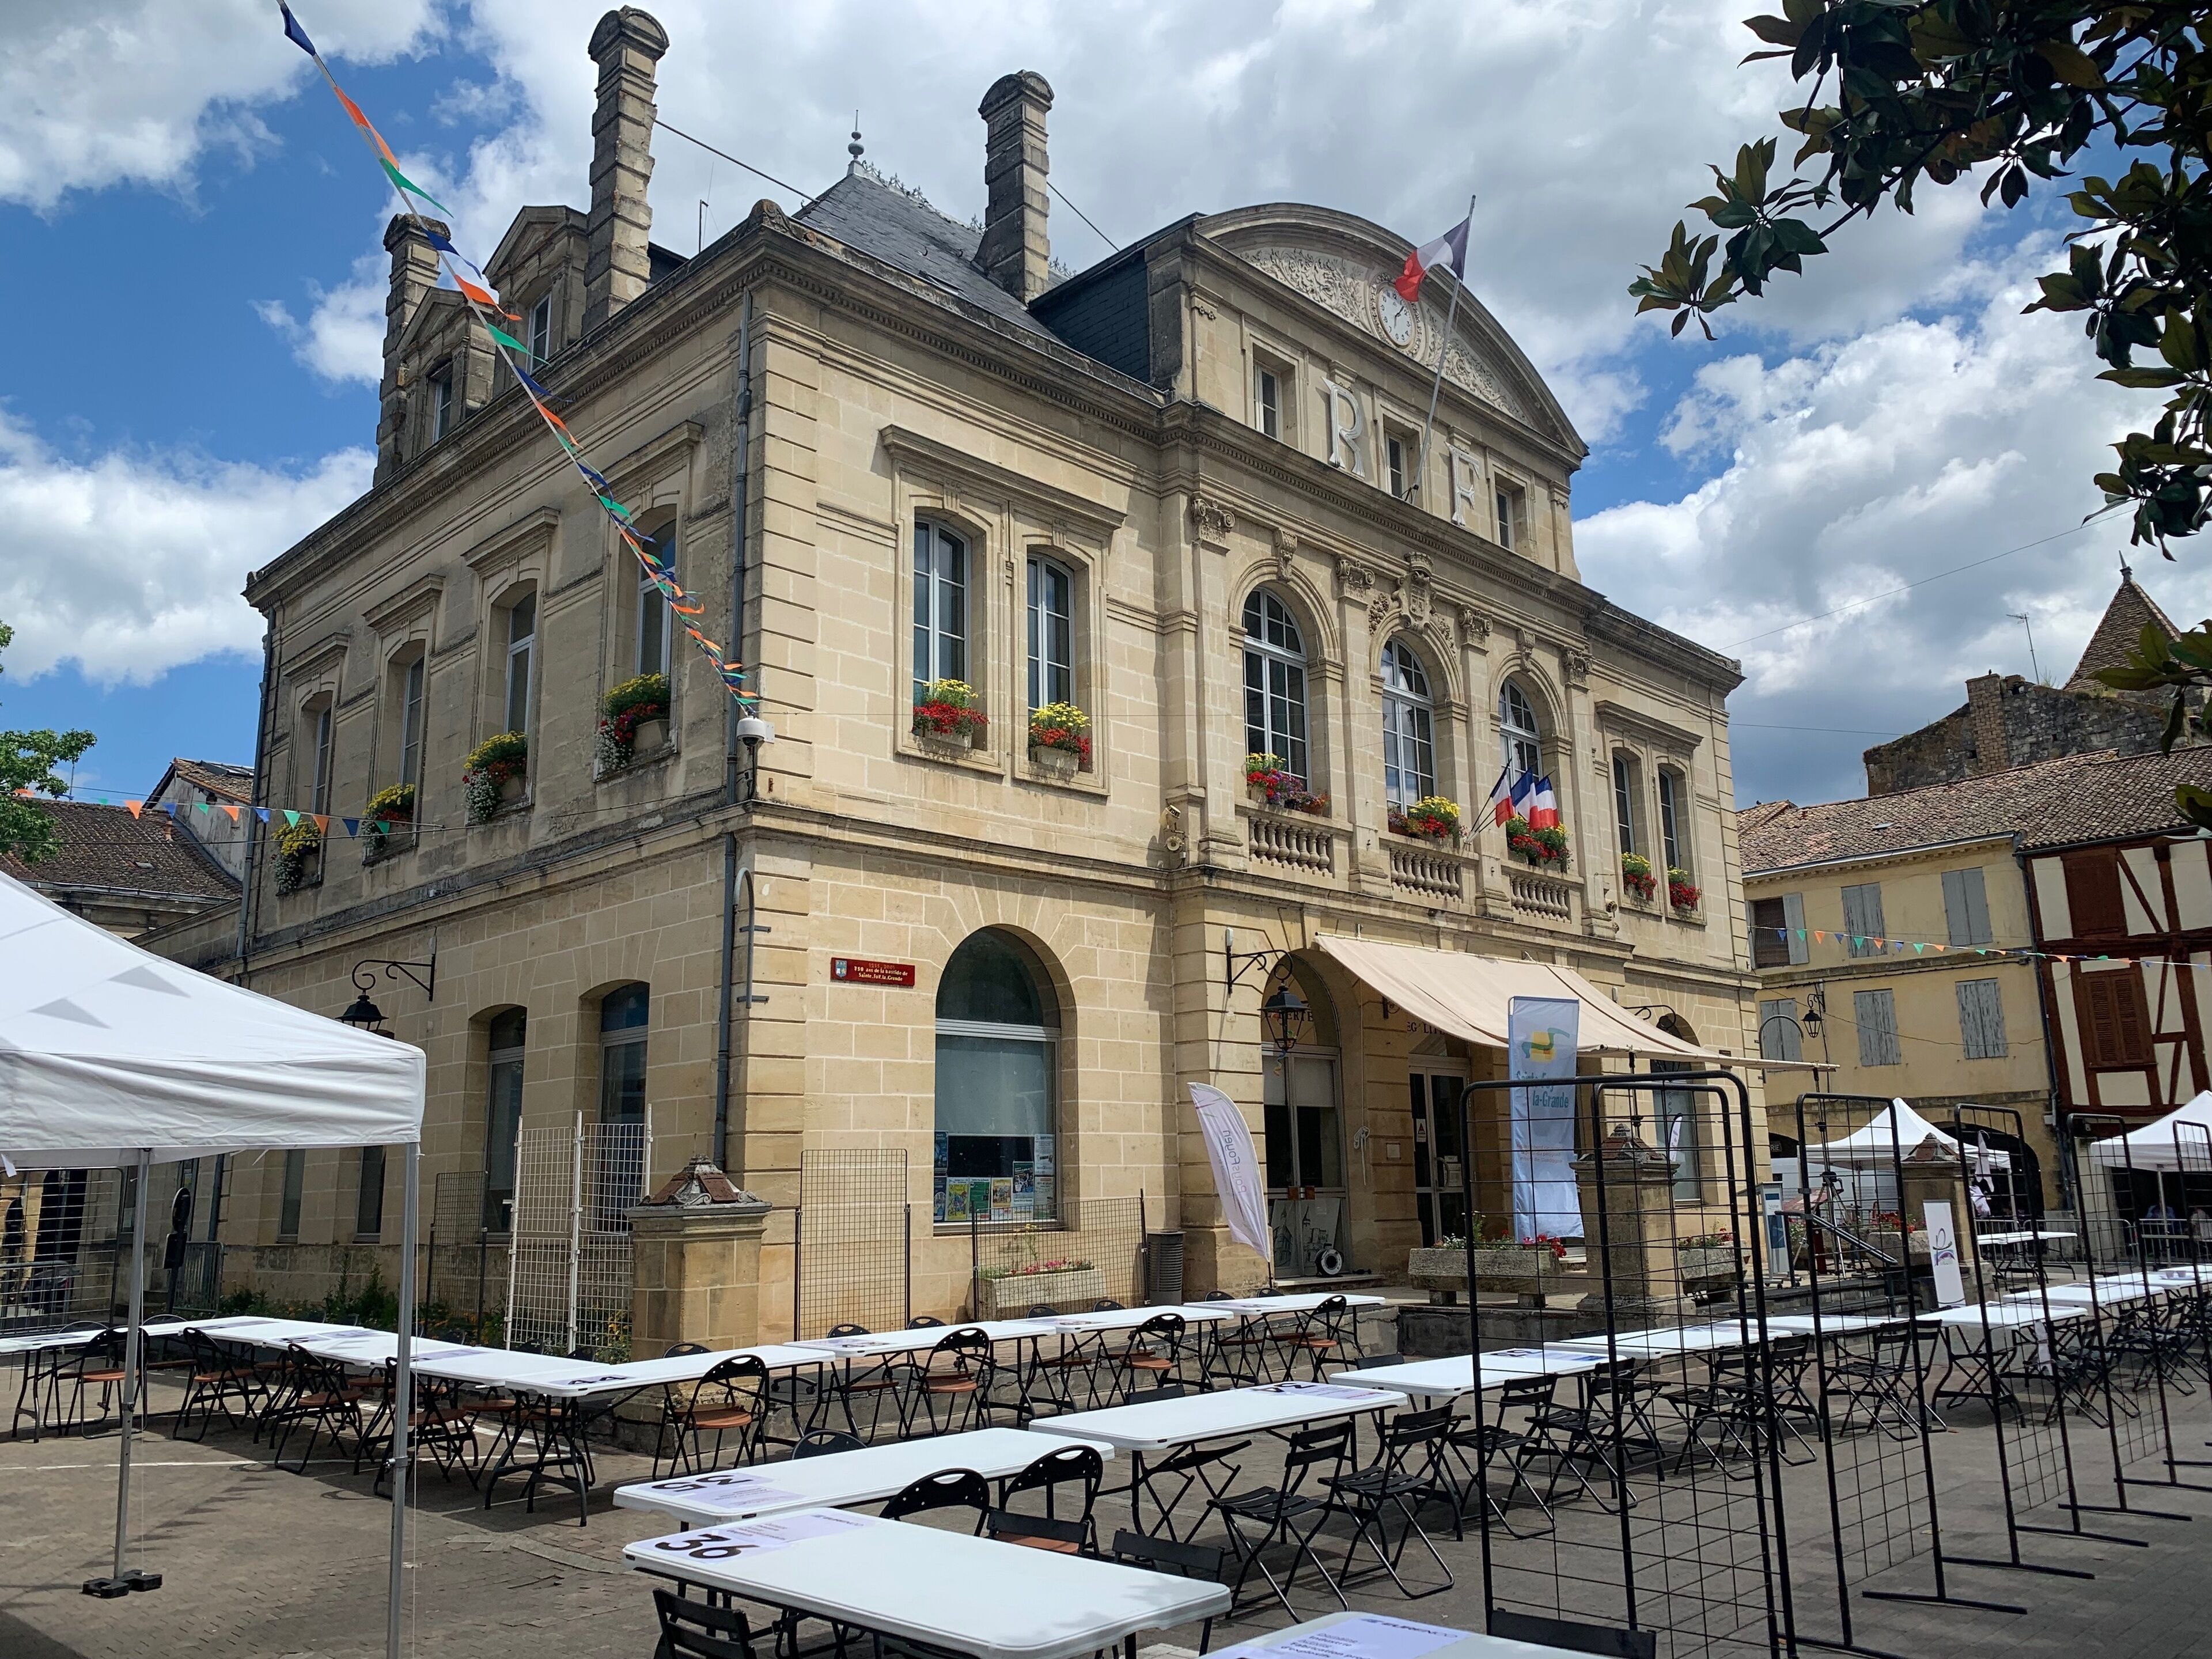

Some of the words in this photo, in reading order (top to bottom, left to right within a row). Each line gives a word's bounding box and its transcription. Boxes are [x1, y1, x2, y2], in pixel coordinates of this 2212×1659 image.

[1321, 376, 1365, 478] R
[1444, 441, 1480, 527] F
[1532, 1090, 1569, 1109] la-Grande
[651, 1475, 753, 1492] 35
[654, 1533, 760, 1559] 36
[1290, 1642, 1344, 1656] Fabrication
[1308, 1635, 1353, 1647] Industrie
